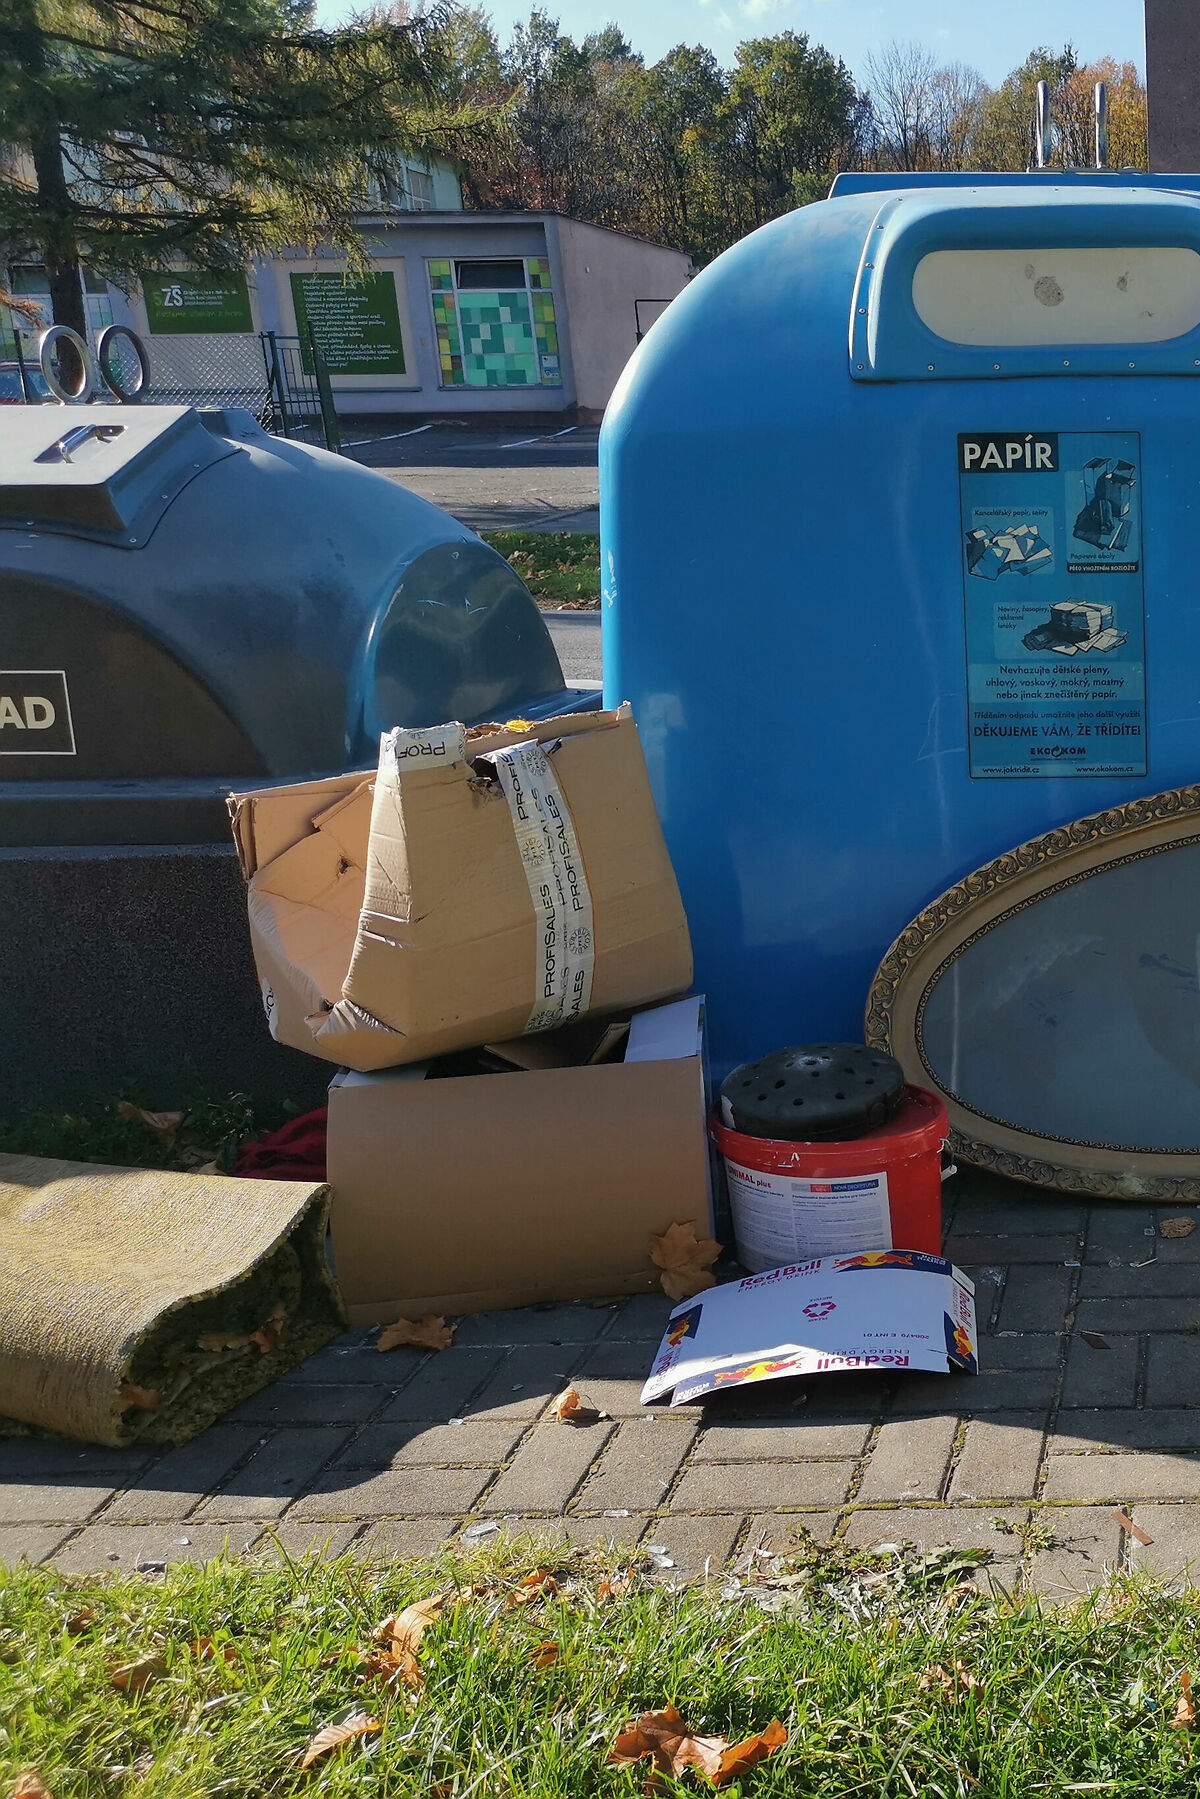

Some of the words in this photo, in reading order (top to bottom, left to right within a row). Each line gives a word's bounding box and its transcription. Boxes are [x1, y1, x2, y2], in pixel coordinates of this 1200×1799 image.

[963, 433, 1054, 469] PAPÍR
[974, 508, 1012, 517] Kancelářský
[1013, 508, 1031, 517] papír,
[997, 605, 1021, 613] Noviny,
[1000, 665, 1050, 676] Nevhazujte
[1052, 665, 1081, 674] dětské
[1083, 665, 1110, 676] pleny,
[1020, 678, 1058, 688] voskový,
[1060, 677, 1090, 687] mokrý,
[1092, 677, 1125, 687] mastný
[996, 691, 1019, 699] nebo
[1020, 690, 1042, 701] jinak
[1044, 689, 1090, 700] znečištěný
[1091, 689, 1118, 700] papír.
[1008, 710, 1039, 720] odpadu
[1077, 710, 1094, 720] jeho
[973, 723, 1038, 737] DĚKUJEME
[1041, 722, 1074, 739] VÁM,
[1076, 722, 1091, 737] ŽE
[1094, 721, 1141, 737] TŘÍDÍTE!
[545, 794, 584, 912] PROFISALES
[540, 884, 556, 998] PROFISALES
[756, 1180, 772, 1189] plus
[739, 1269, 781, 1288] Red
[782, 1259, 822, 1277] Bull
[737, 1278, 782, 1293] ENERGY
[786, 1269, 821, 1281] DRINK
[816, 1355, 861, 1370] Bull
[864, 1355, 910, 1367] Red
